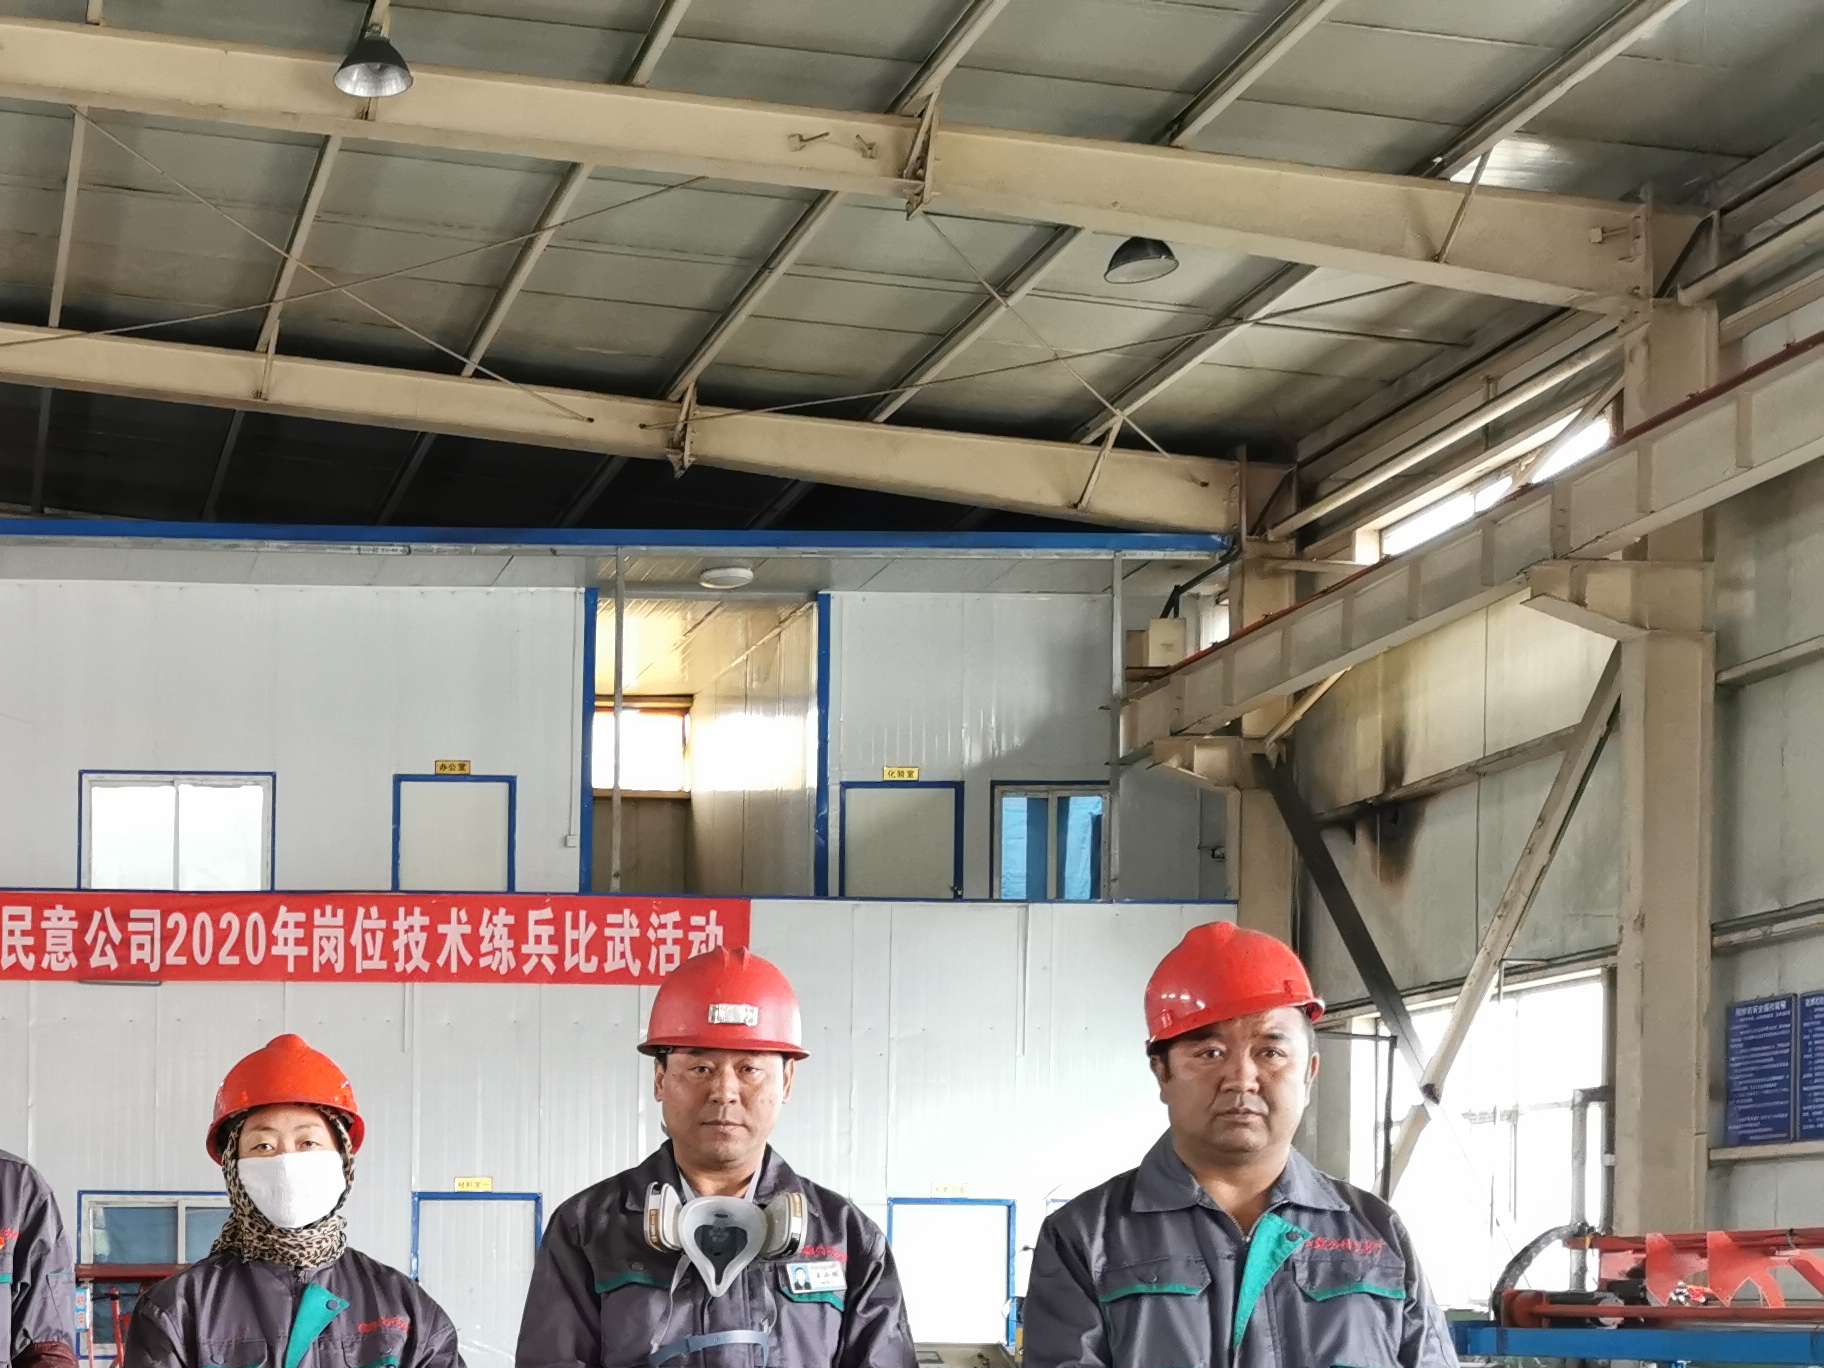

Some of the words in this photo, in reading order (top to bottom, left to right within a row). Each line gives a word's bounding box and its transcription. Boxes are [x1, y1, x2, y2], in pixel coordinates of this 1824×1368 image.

[0, 903, 724, 977] 民意公司2020年岗位技术练兵比武活动
